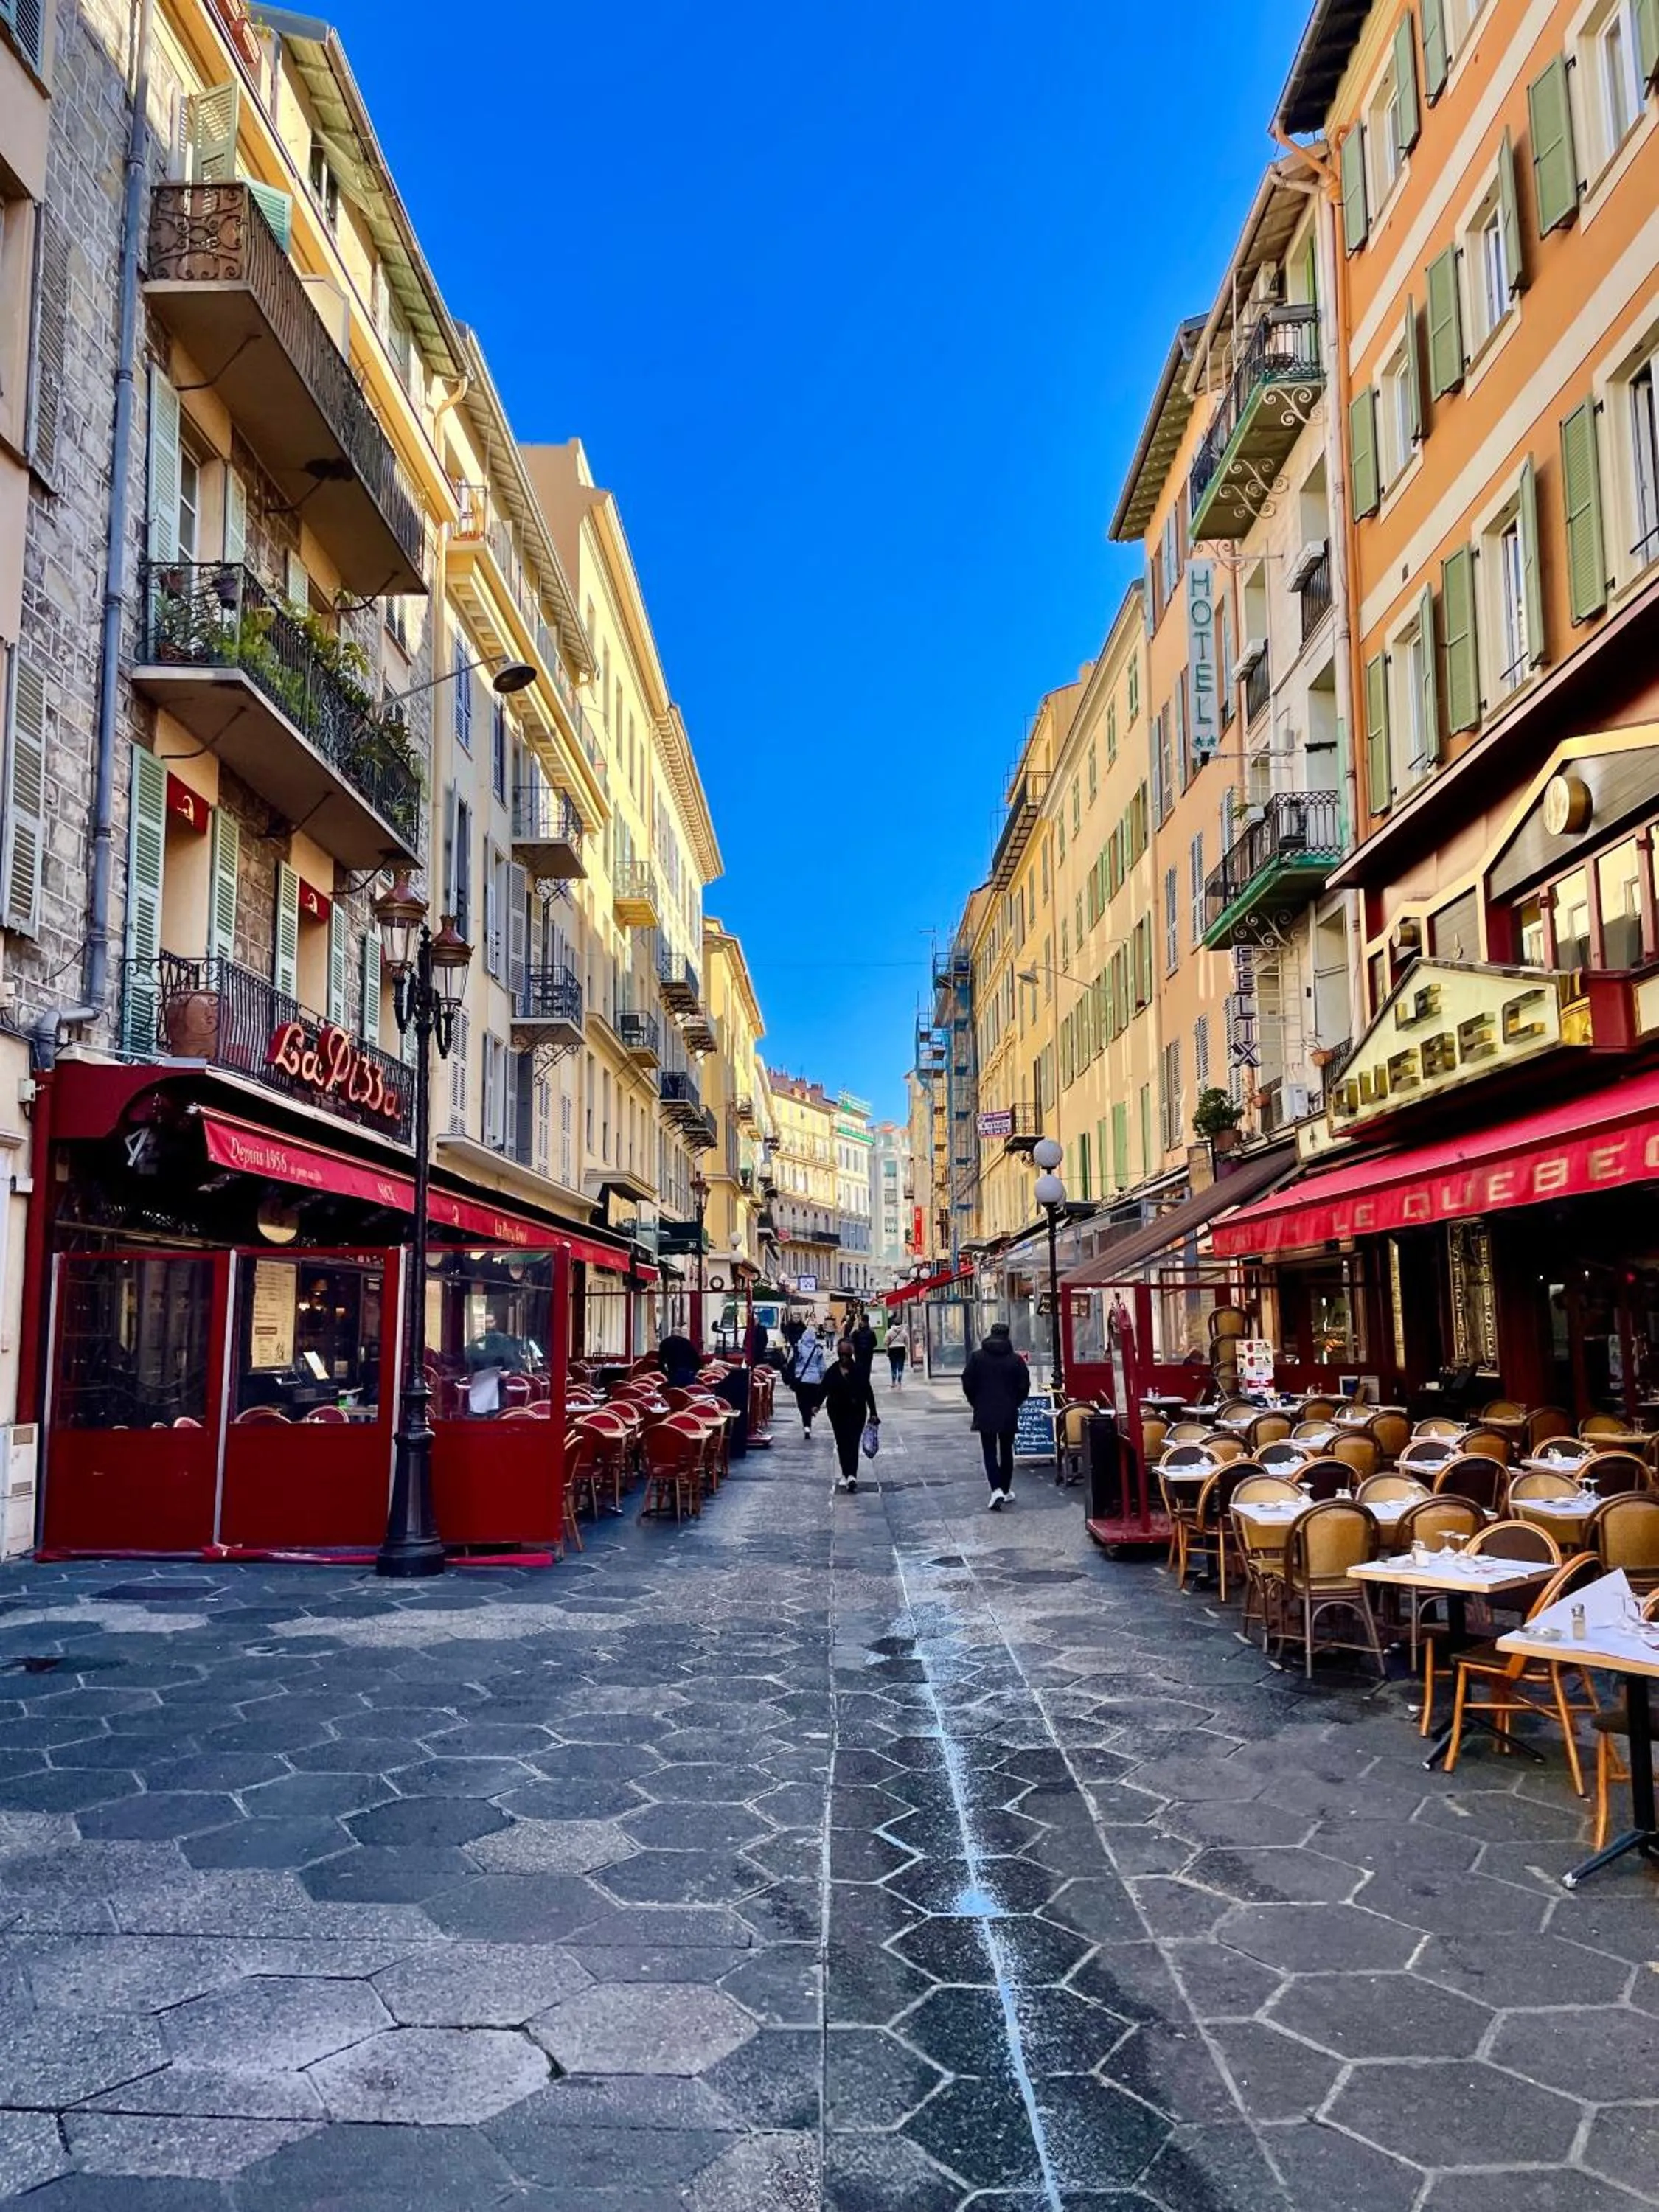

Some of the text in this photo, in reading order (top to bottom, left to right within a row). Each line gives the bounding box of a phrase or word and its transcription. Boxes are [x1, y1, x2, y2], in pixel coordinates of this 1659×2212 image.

[1190, 568, 1213, 725] HOTEL
[1237, 946, 1260, 1065] FELIX
[1332, 988, 1547, 1117] QUEBEC
[1394, 983, 1442, 1032] LE
[274, 1022, 402, 1121] La Pizza
[229, 1135, 264, 1169] Depuis
[1332, 1203, 1375, 1233] LE
